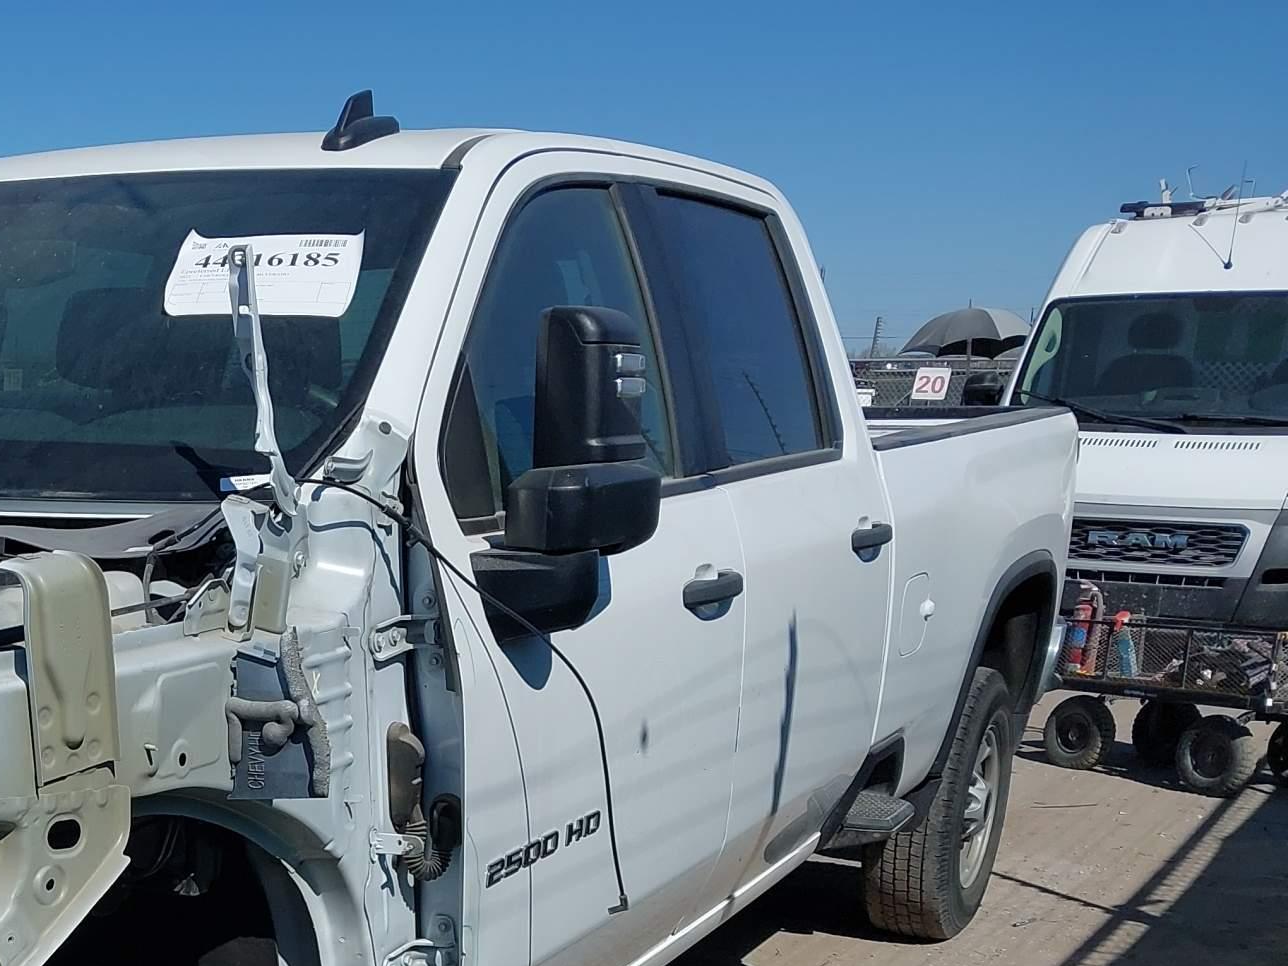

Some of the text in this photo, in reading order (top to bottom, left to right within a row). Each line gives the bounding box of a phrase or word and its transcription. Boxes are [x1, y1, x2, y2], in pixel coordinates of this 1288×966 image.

[915, 375, 946, 394] 20
[1087, 530, 1190, 549] RAM
[485, 809, 601, 889] 2500 HD
